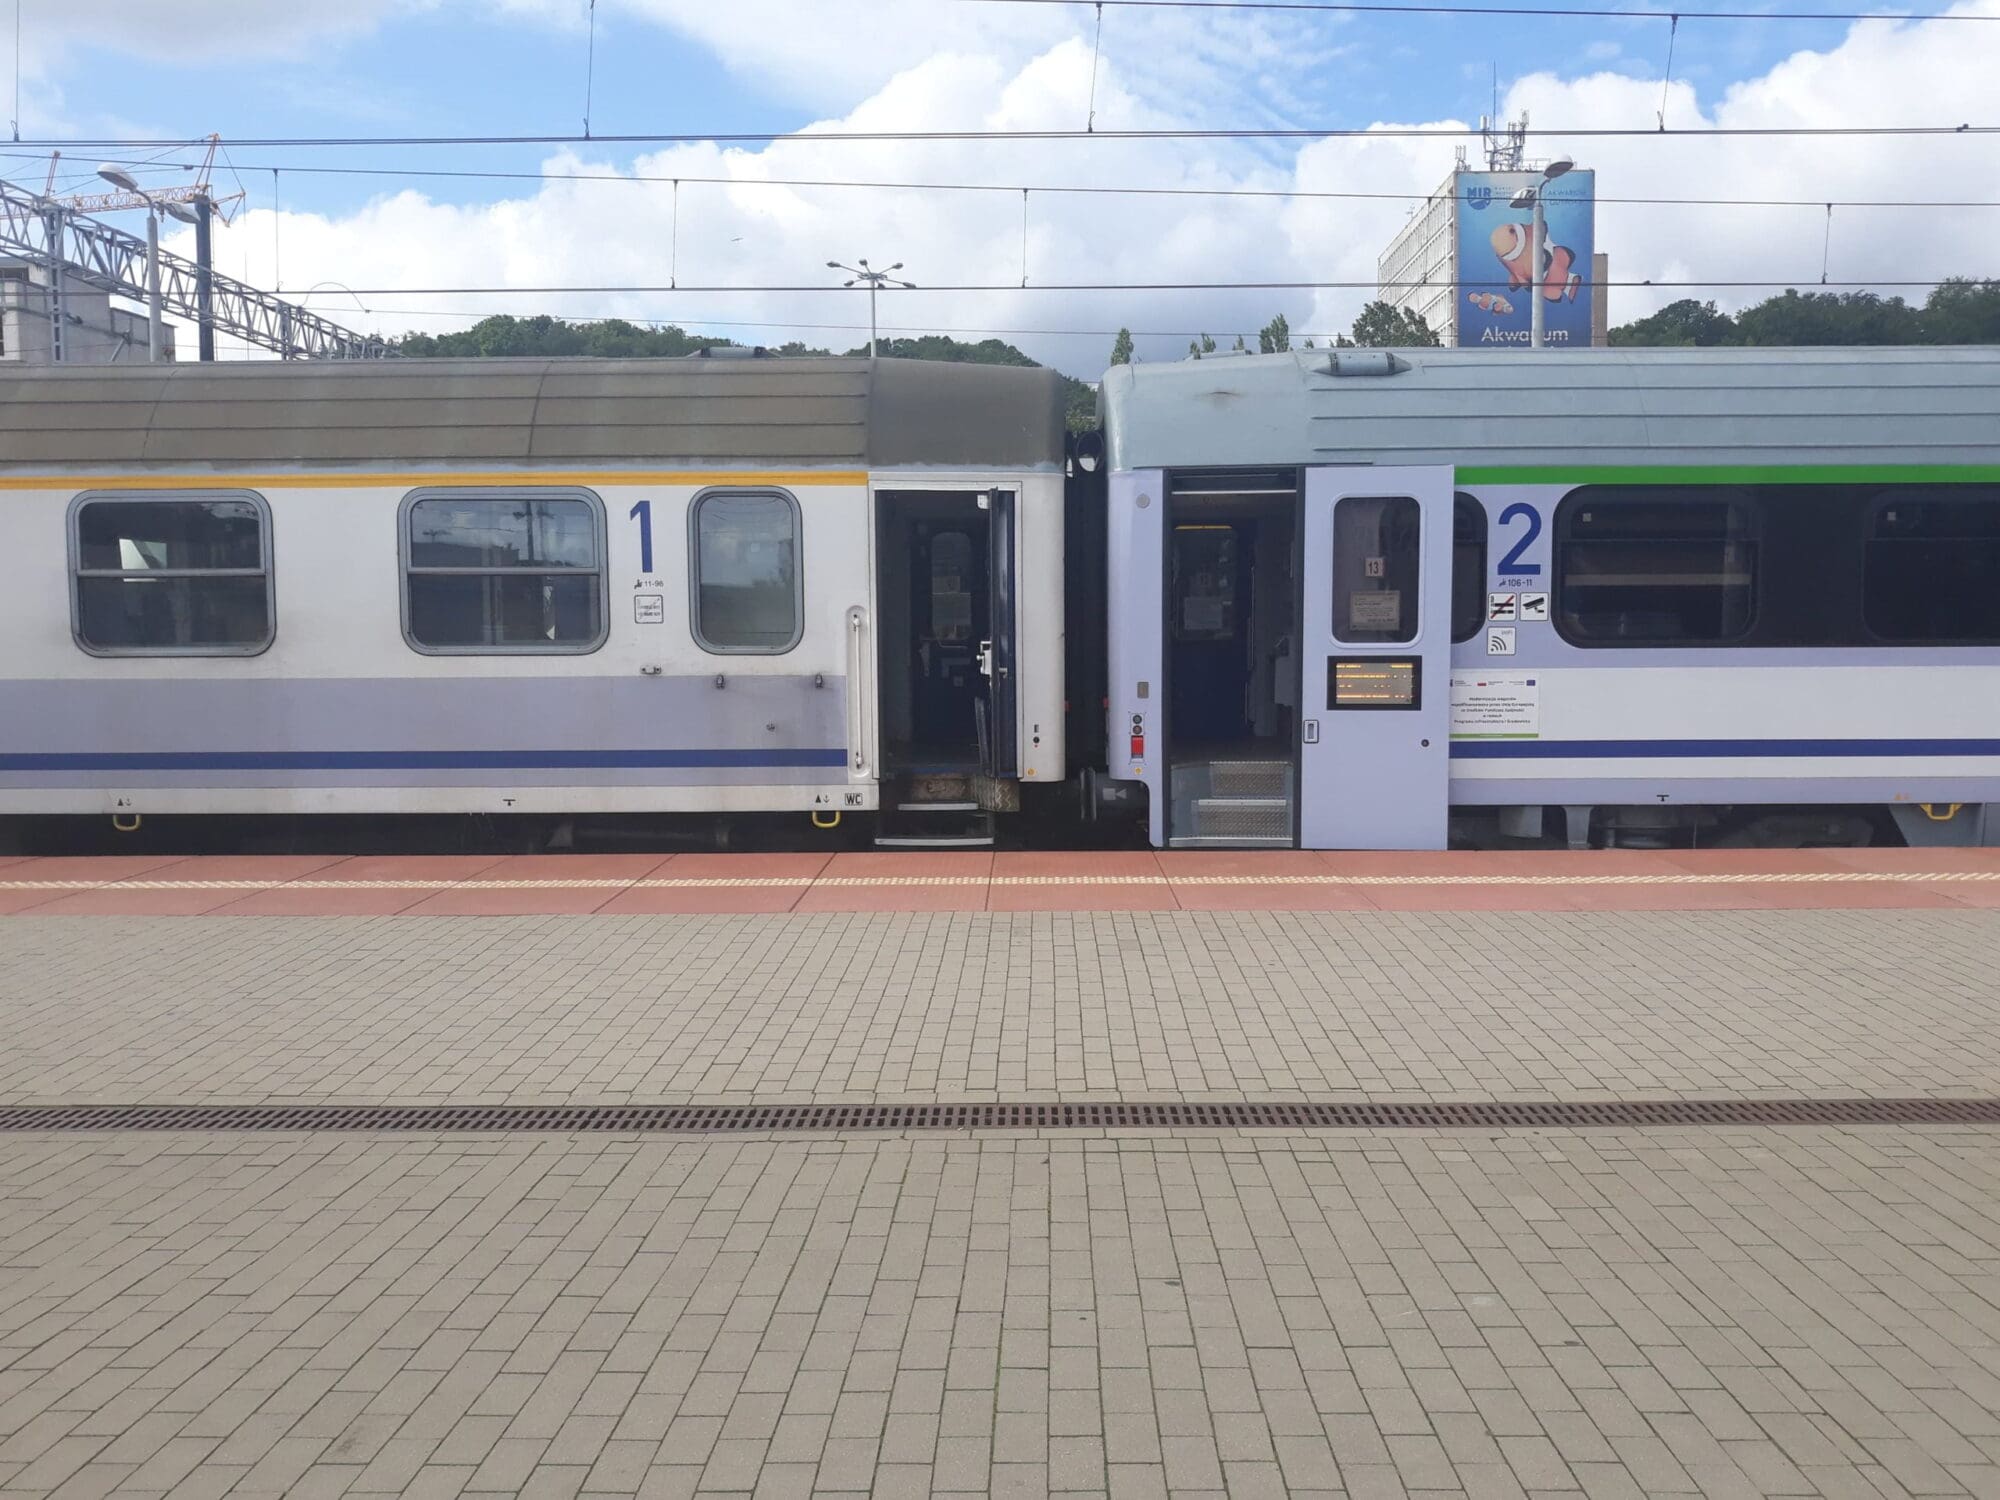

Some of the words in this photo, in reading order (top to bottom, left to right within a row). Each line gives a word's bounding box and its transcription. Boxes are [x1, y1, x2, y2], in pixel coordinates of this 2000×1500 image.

[1466, 186, 1492, 198] MIR
[1481, 326, 1569, 342] Akwaum
[629, 500, 653, 573] 1
[1497, 502, 1542, 576] 2
[1368, 560, 1379, 575] 13
[1507, 578, 1533, 587] 106-11
[846, 794, 861, 805] WC
